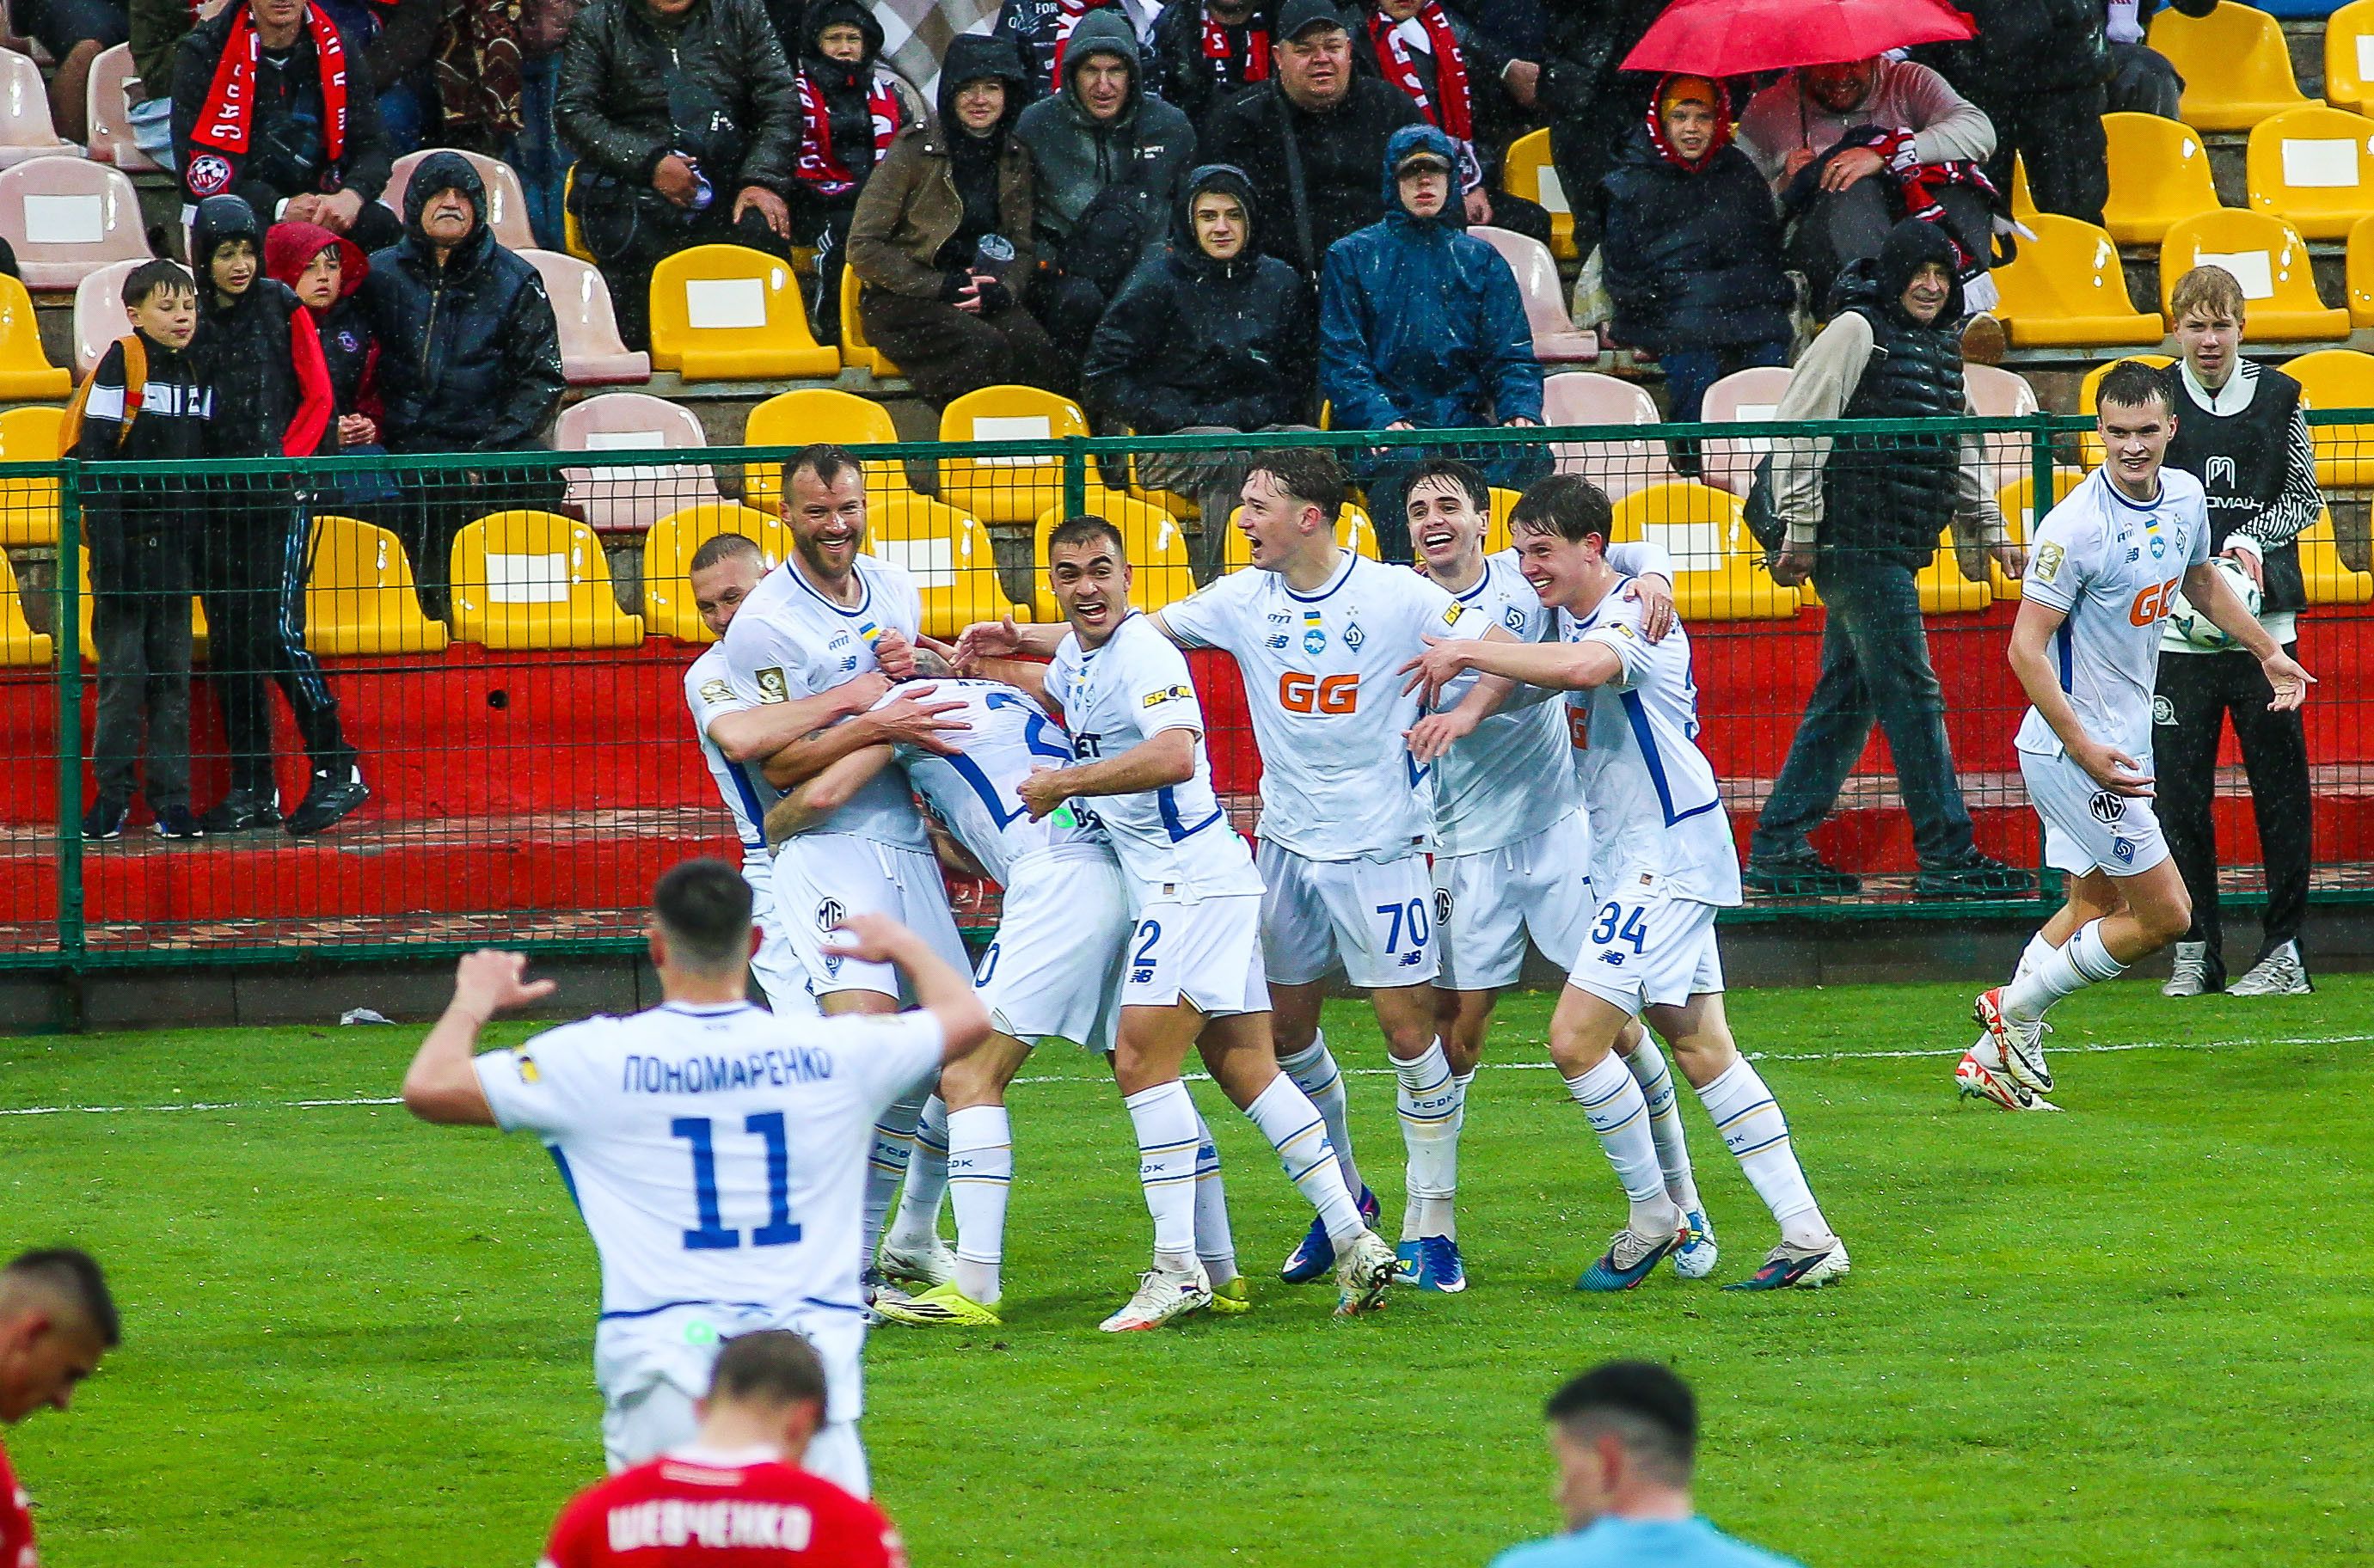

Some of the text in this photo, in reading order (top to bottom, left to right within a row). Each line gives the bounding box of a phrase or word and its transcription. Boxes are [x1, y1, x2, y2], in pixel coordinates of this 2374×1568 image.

[1279, 671, 1360, 714] GG
[2091, 793, 2124, 823] MG
[1133, 919, 1161, 967] 2
[1376, 897, 1429, 955] 70
[1592, 902, 1647, 955] 34
[623, 1045, 834, 1094] ПОНОМАРЕНКО
[671, 1112, 801, 1252] 11
